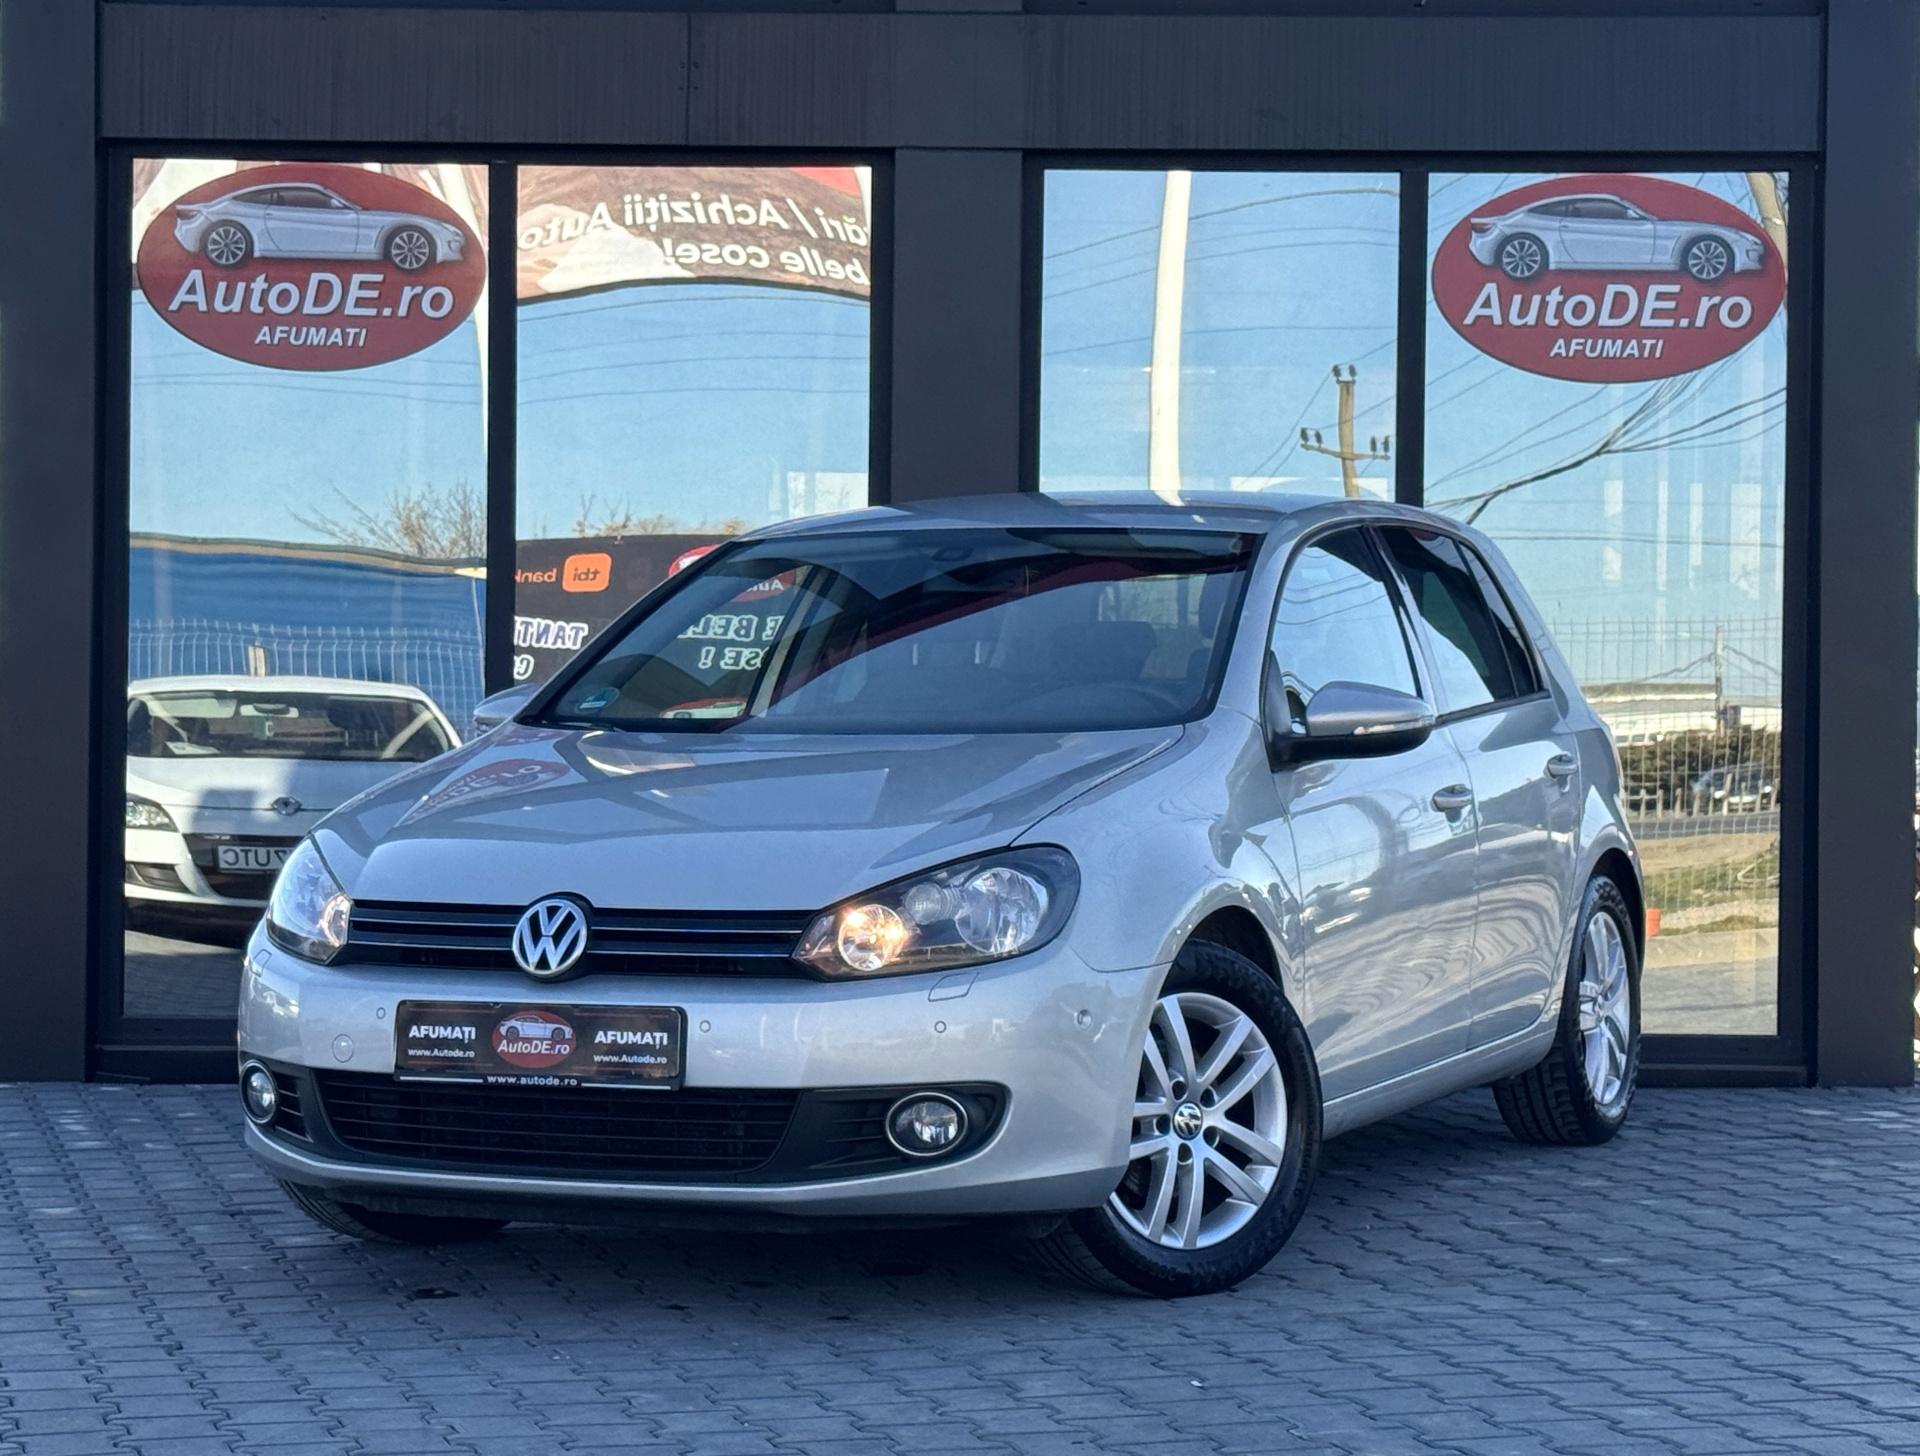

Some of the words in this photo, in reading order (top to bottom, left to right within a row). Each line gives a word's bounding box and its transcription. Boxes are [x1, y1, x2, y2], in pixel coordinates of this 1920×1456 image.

[168, 269, 454, 319] AutoDE.ro
[1462, 282, 1753, 330] AutoDE.ro
[254, 326, 367, 348] AFUMATI
[1549, 338, 1664, 360] AFUMATI
[408, 1048, 475, 1059] www.Autode.ro
[497, 1039, 570, 1056] AutoDE.ro
[593, 1053, 667, 1065] www.Autode.ro
[487, 1075, 578, 1087] www.autode.ro
